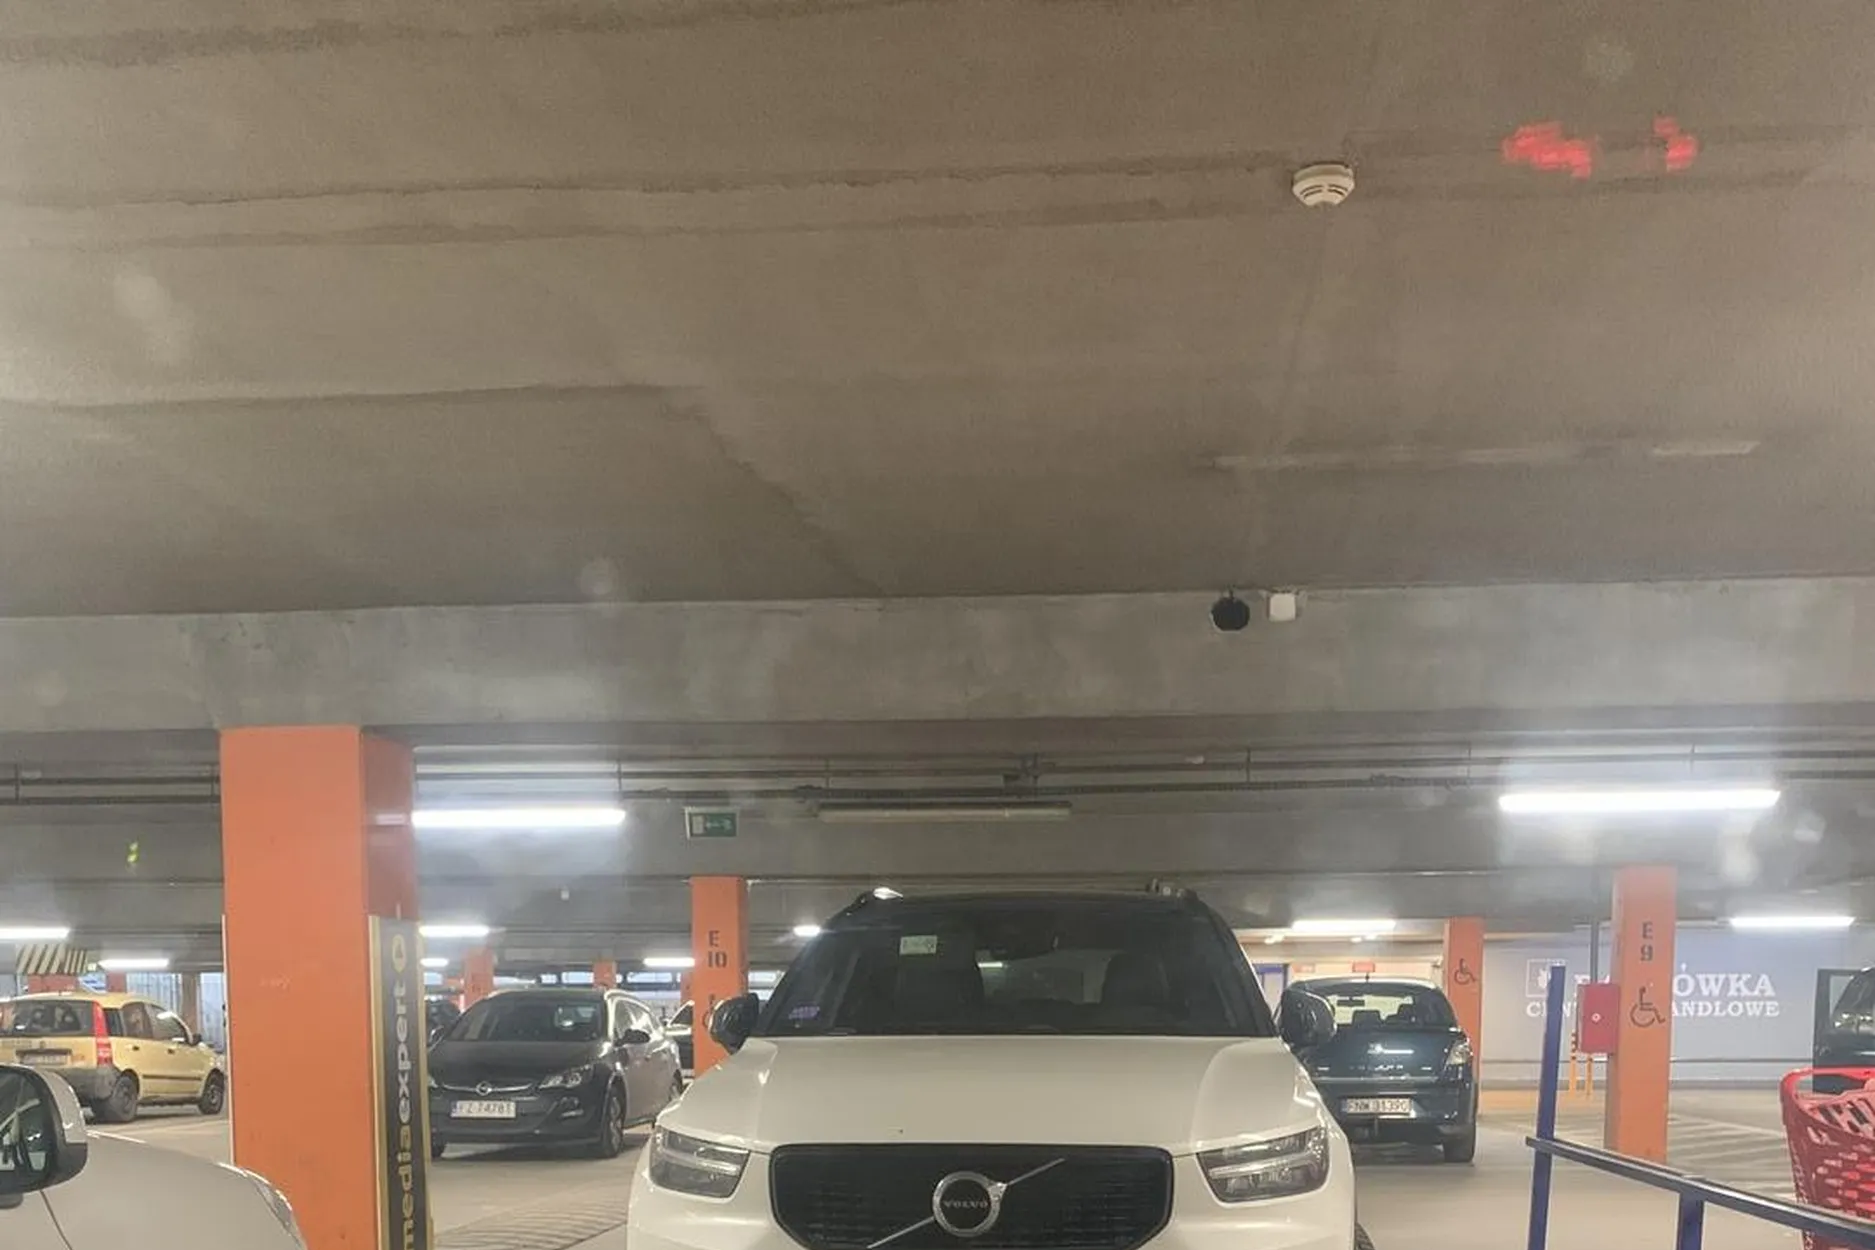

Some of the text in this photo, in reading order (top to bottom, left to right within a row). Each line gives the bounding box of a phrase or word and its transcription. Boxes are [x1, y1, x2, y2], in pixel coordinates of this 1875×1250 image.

[708, 930, 720, 947] E
[1641, 921, 1653, 940] E
[708, 951, 728, 968] 10
[1640, 944, 1653, 962] 9
[1671, 1001, 1780, 1017] ANDLOWE
[943, 1200, 988, 1209] VOLVO
